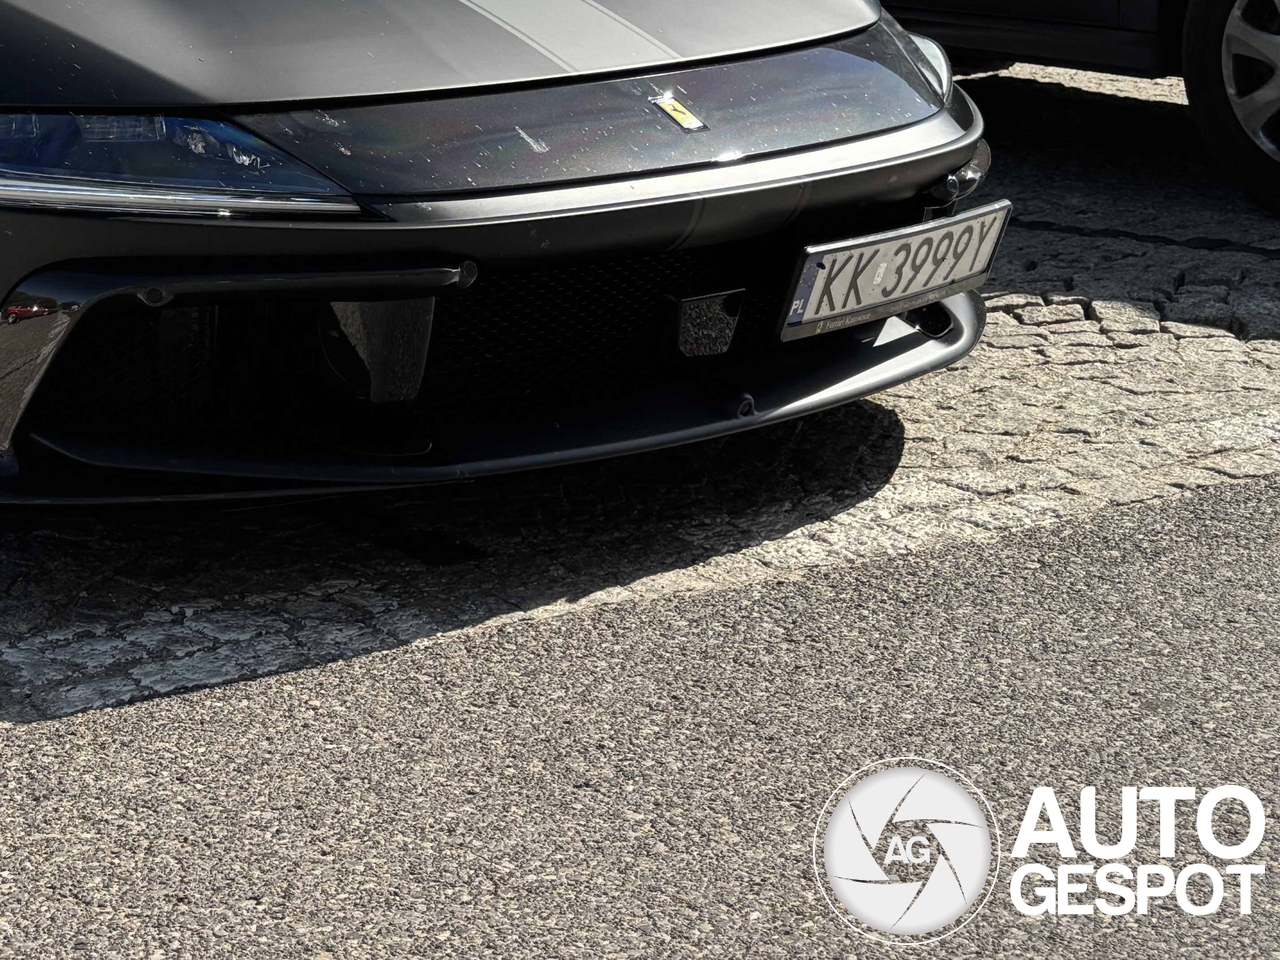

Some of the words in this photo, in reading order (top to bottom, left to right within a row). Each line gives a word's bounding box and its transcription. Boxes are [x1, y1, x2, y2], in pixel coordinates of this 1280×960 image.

[814, 249, 880, 315] KK
[881, 216, 997, 297] 3999Y
[789, 300, 804, 316] PL
[825, 317, 845, 330] Ferrari
[845, 313, 871, 326] Katowice
